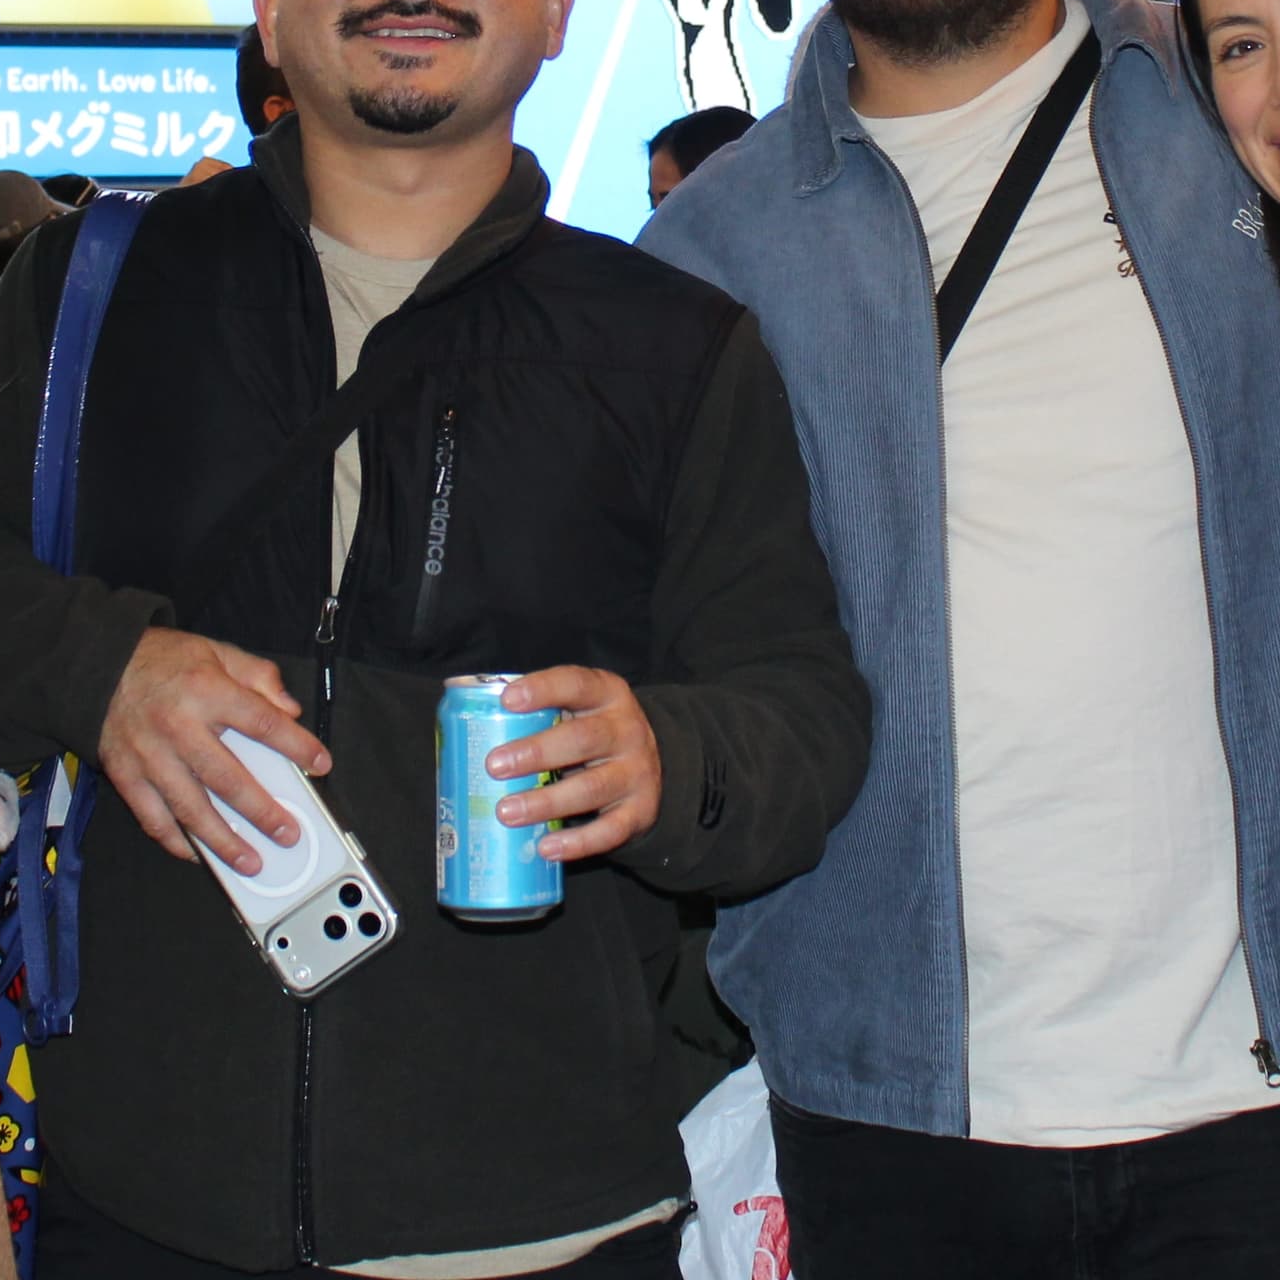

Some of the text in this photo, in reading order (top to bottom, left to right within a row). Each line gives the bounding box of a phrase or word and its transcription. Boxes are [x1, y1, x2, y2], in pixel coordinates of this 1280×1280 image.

[7, 66, 88, 93] Earth.
[97, 67, 157, 95] Love
[162, 67, 217, 95] Life.
